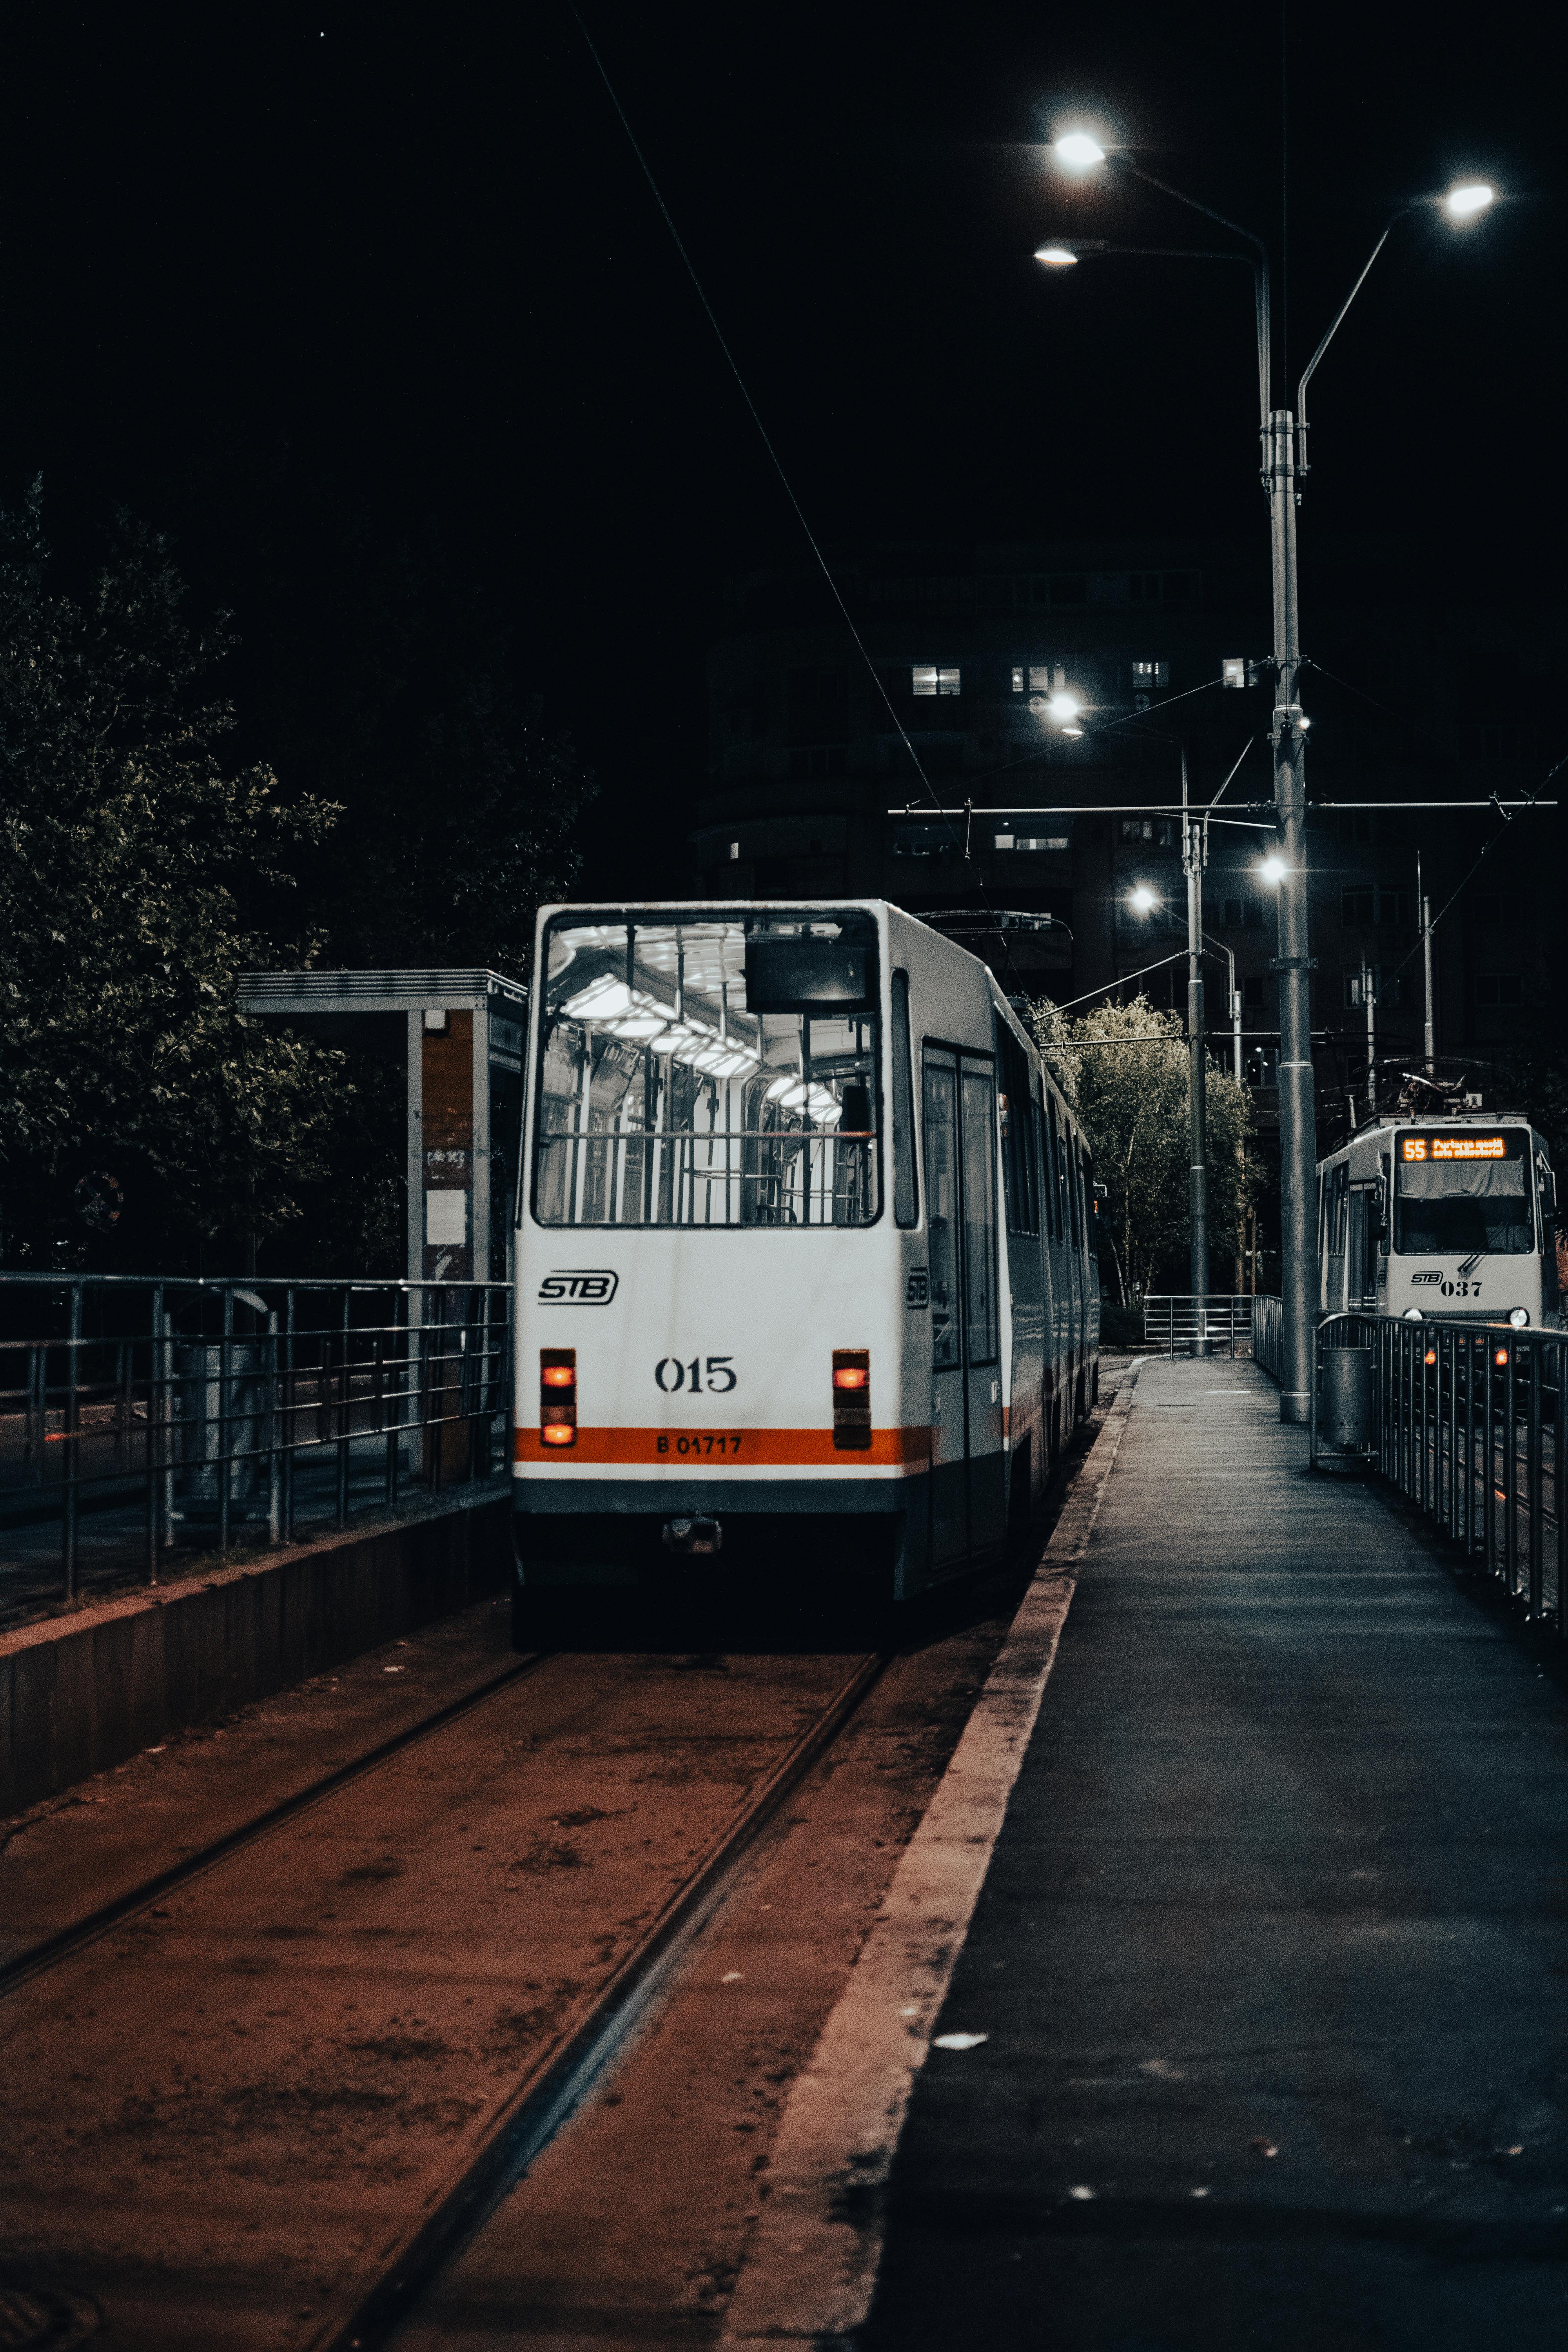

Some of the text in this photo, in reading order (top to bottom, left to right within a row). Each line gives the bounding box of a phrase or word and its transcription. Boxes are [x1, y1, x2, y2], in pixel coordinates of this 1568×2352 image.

[1405, 1141, 1425, 1159] 55
[538, 1277, 610, 1298] STB
[907, 1275, 927, 1301] STB
[1411, 1274, 1440, 1283] STB
[1441, 1281, 1483, 1297] 037
[655, 1356, 737, 1393] 015
[657, 1436, 742, 1455] B 01717
